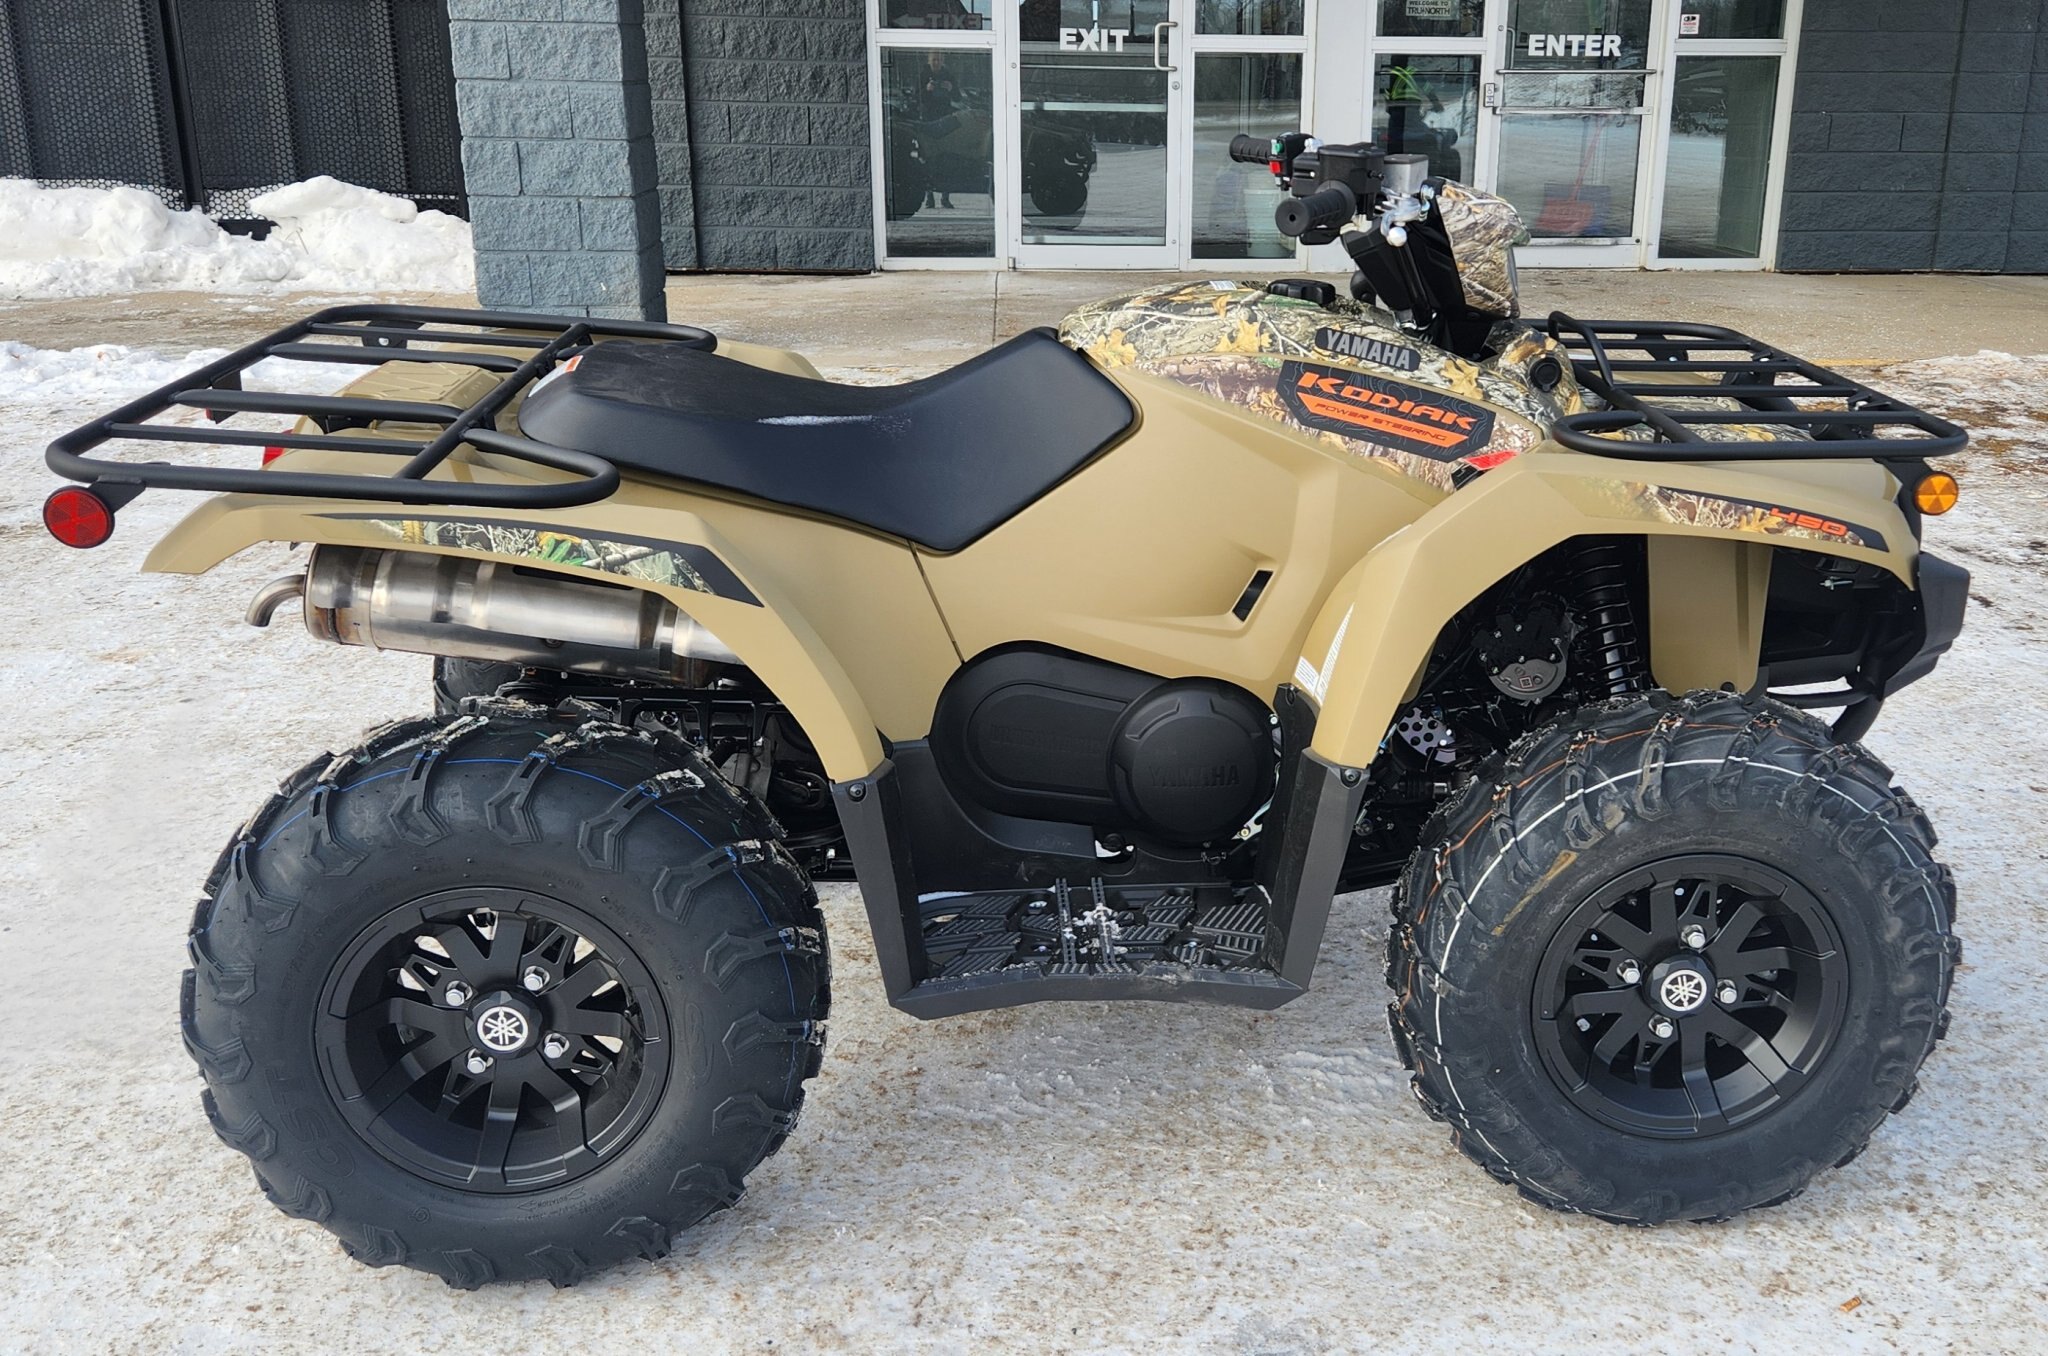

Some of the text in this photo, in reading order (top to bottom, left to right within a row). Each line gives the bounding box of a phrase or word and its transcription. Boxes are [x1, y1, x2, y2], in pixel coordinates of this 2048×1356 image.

[1060, 28, 1129, 52] EXIT
[1528, 34, 1621, 56] ENTER
[1326, 330, 1412, 371] YAMAHA
[1298, 372, 1477, 430] KODIAK
[1314, 402, 1448, 442] POWER STEERING
[1769, 507, 1848, 537] 450
[1148, 764, 1240, 787] YAMAHA
[264, 1066, 356, 1178] CST
